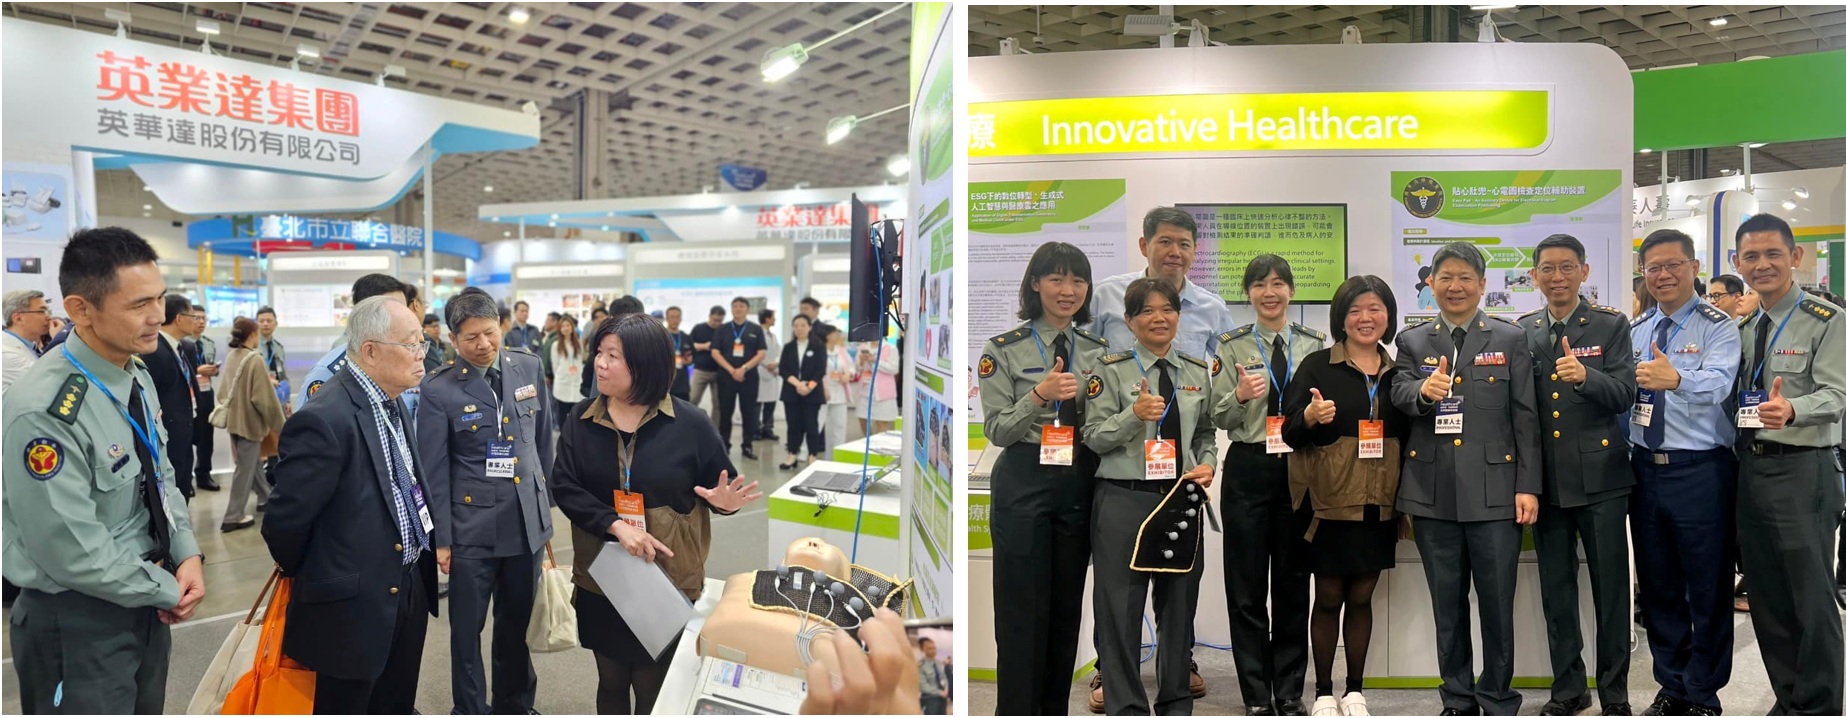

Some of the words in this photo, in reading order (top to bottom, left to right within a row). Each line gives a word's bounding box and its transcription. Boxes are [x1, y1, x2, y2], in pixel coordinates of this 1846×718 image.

[96, 50, 360, 137] 英業達集團
[97, 108, 361, 166] 英華達股份有限公司
[1042, 110, 1218, 145] Innovative
[1229, 107, 1419, 141] Healthcare
[260, 214, 423, 247] 臺北市立聯合醫院
